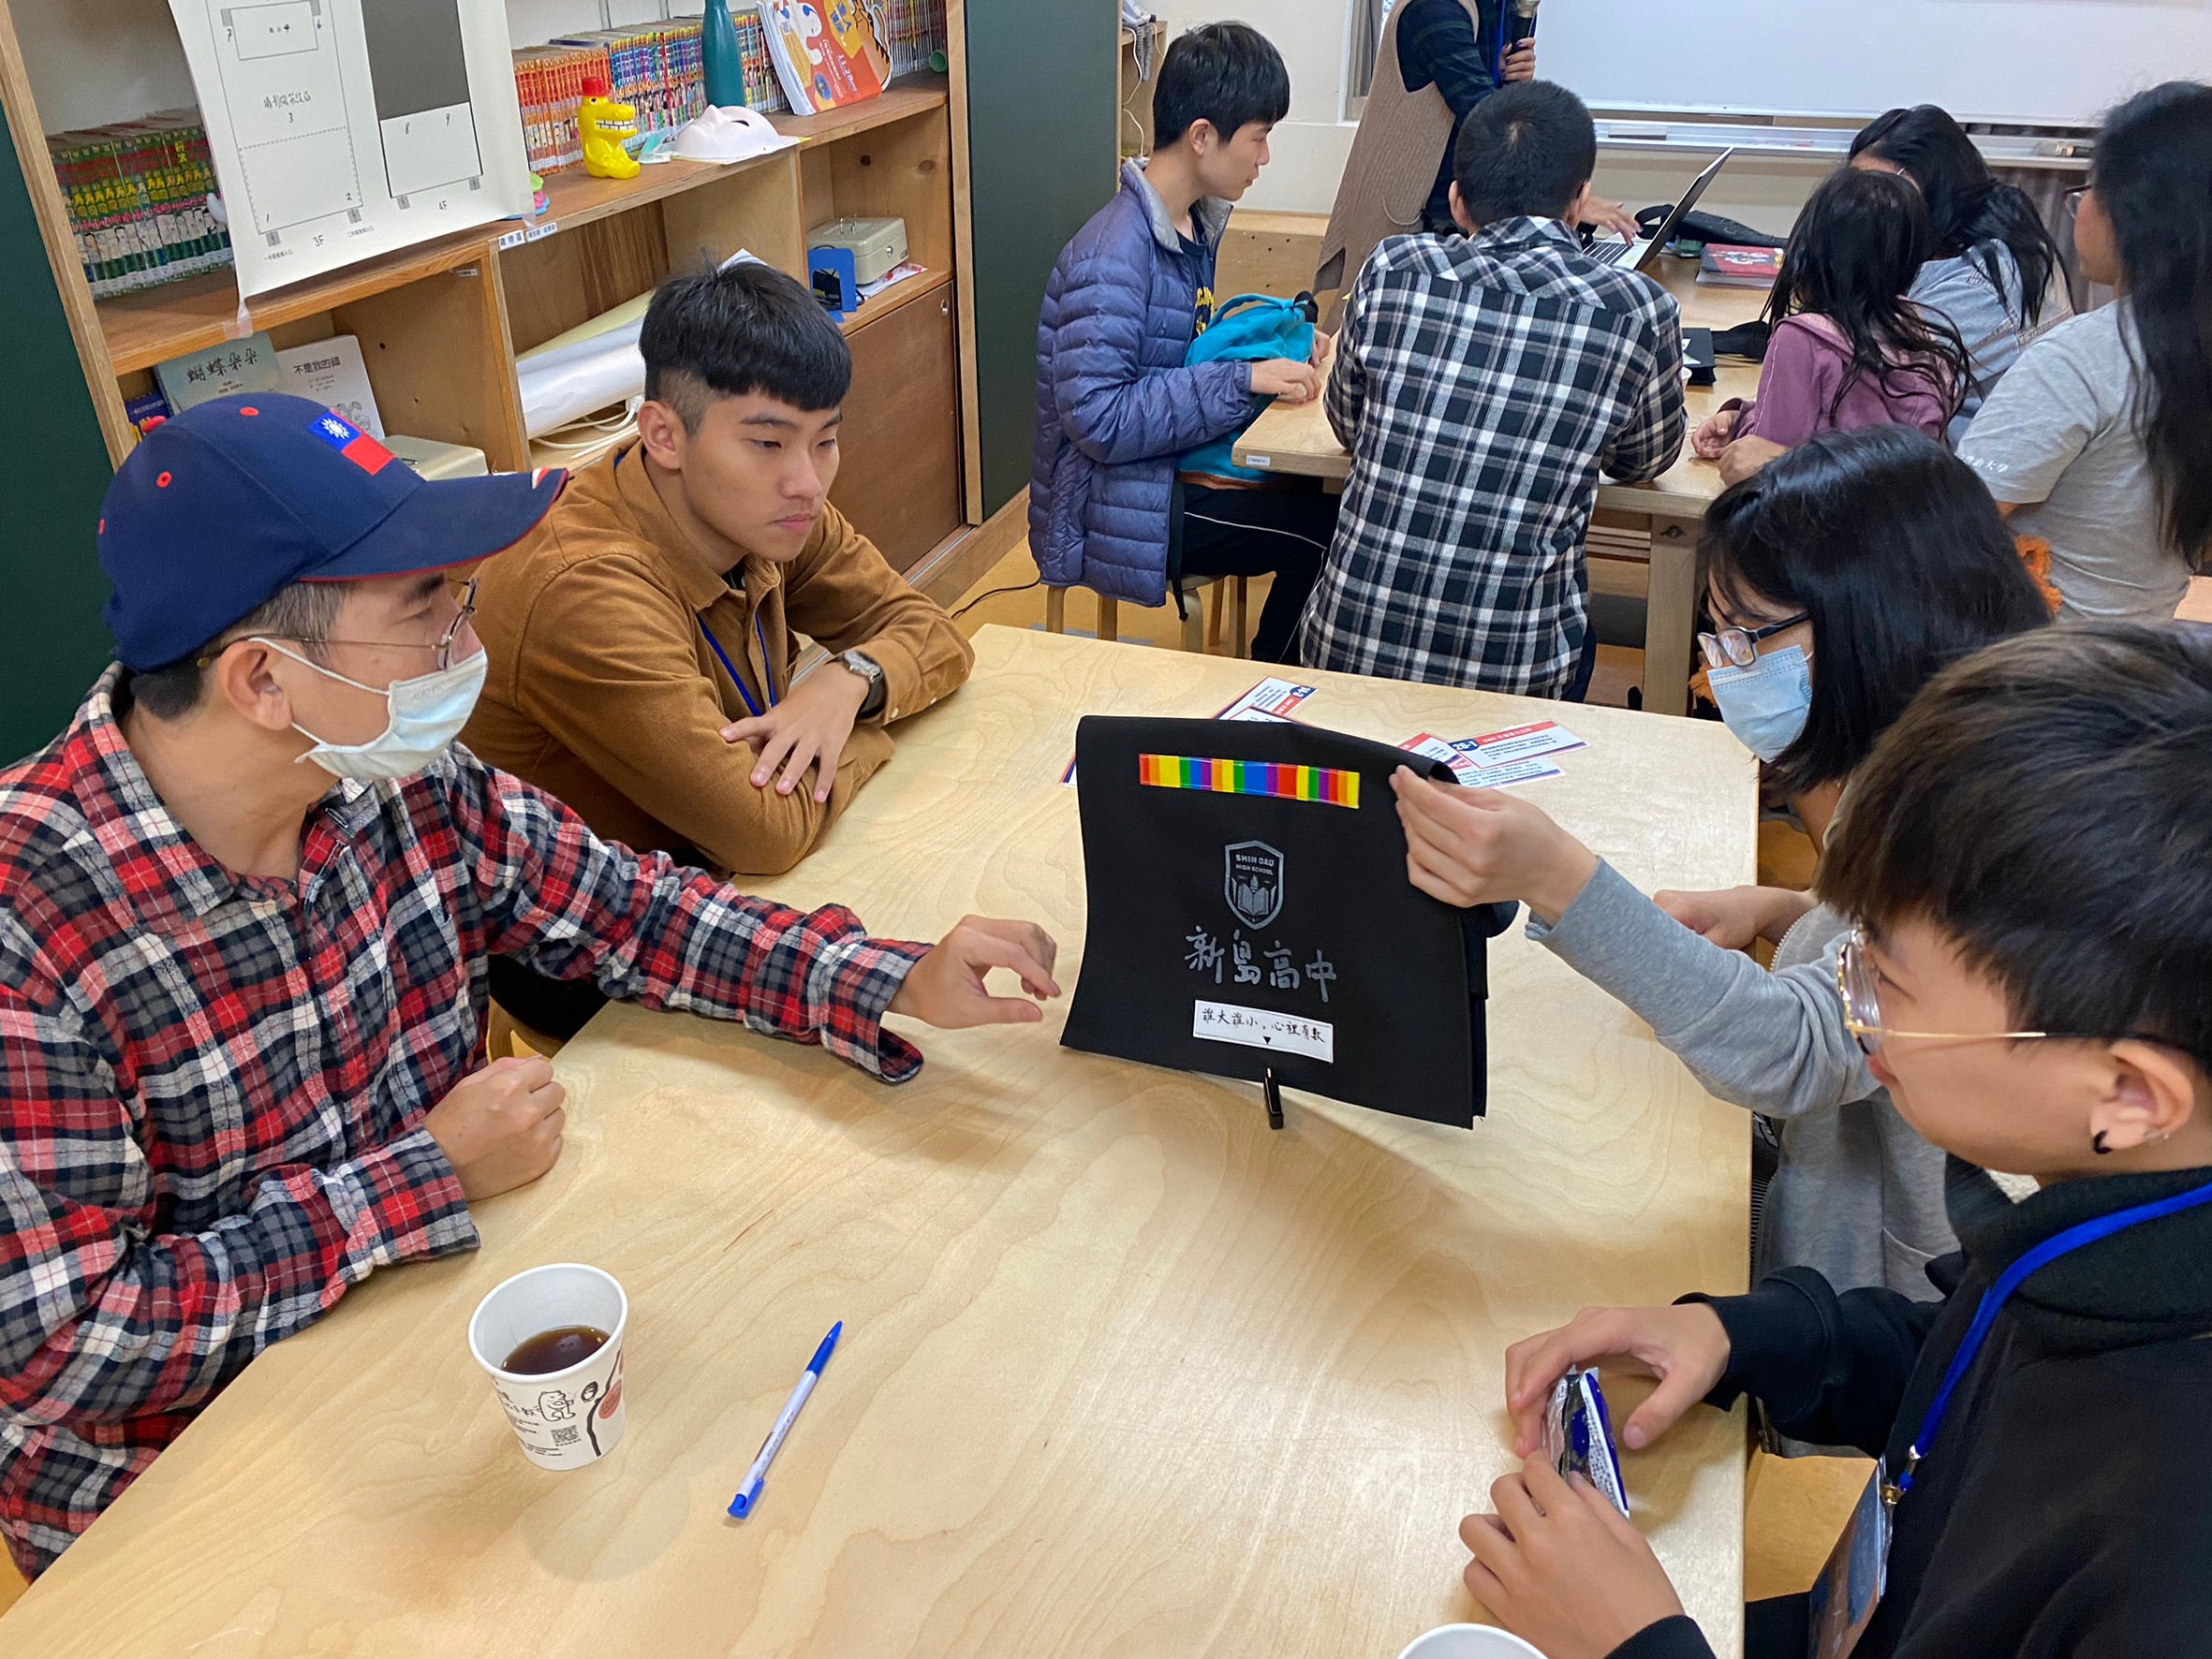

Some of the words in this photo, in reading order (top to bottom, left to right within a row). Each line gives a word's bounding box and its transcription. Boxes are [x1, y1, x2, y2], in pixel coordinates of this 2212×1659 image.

[288, 112, 293, 123] 3
[346, 192, 352, 201] 2
[438, 199, 448, 211] 4F
[312, 234, 324, 248] 3F
[186, 347, 258, 384] 蝴蝶朵朵
[293, 356, 341, 375] 不是我的錯
[1235, 854, 1257, 863] SHIN
[1259, 857, 1275, 867] DAU
[1251, 866, 1274, 875] SCHOOL
[1184, 925, 1337, 1003] 新島高中
